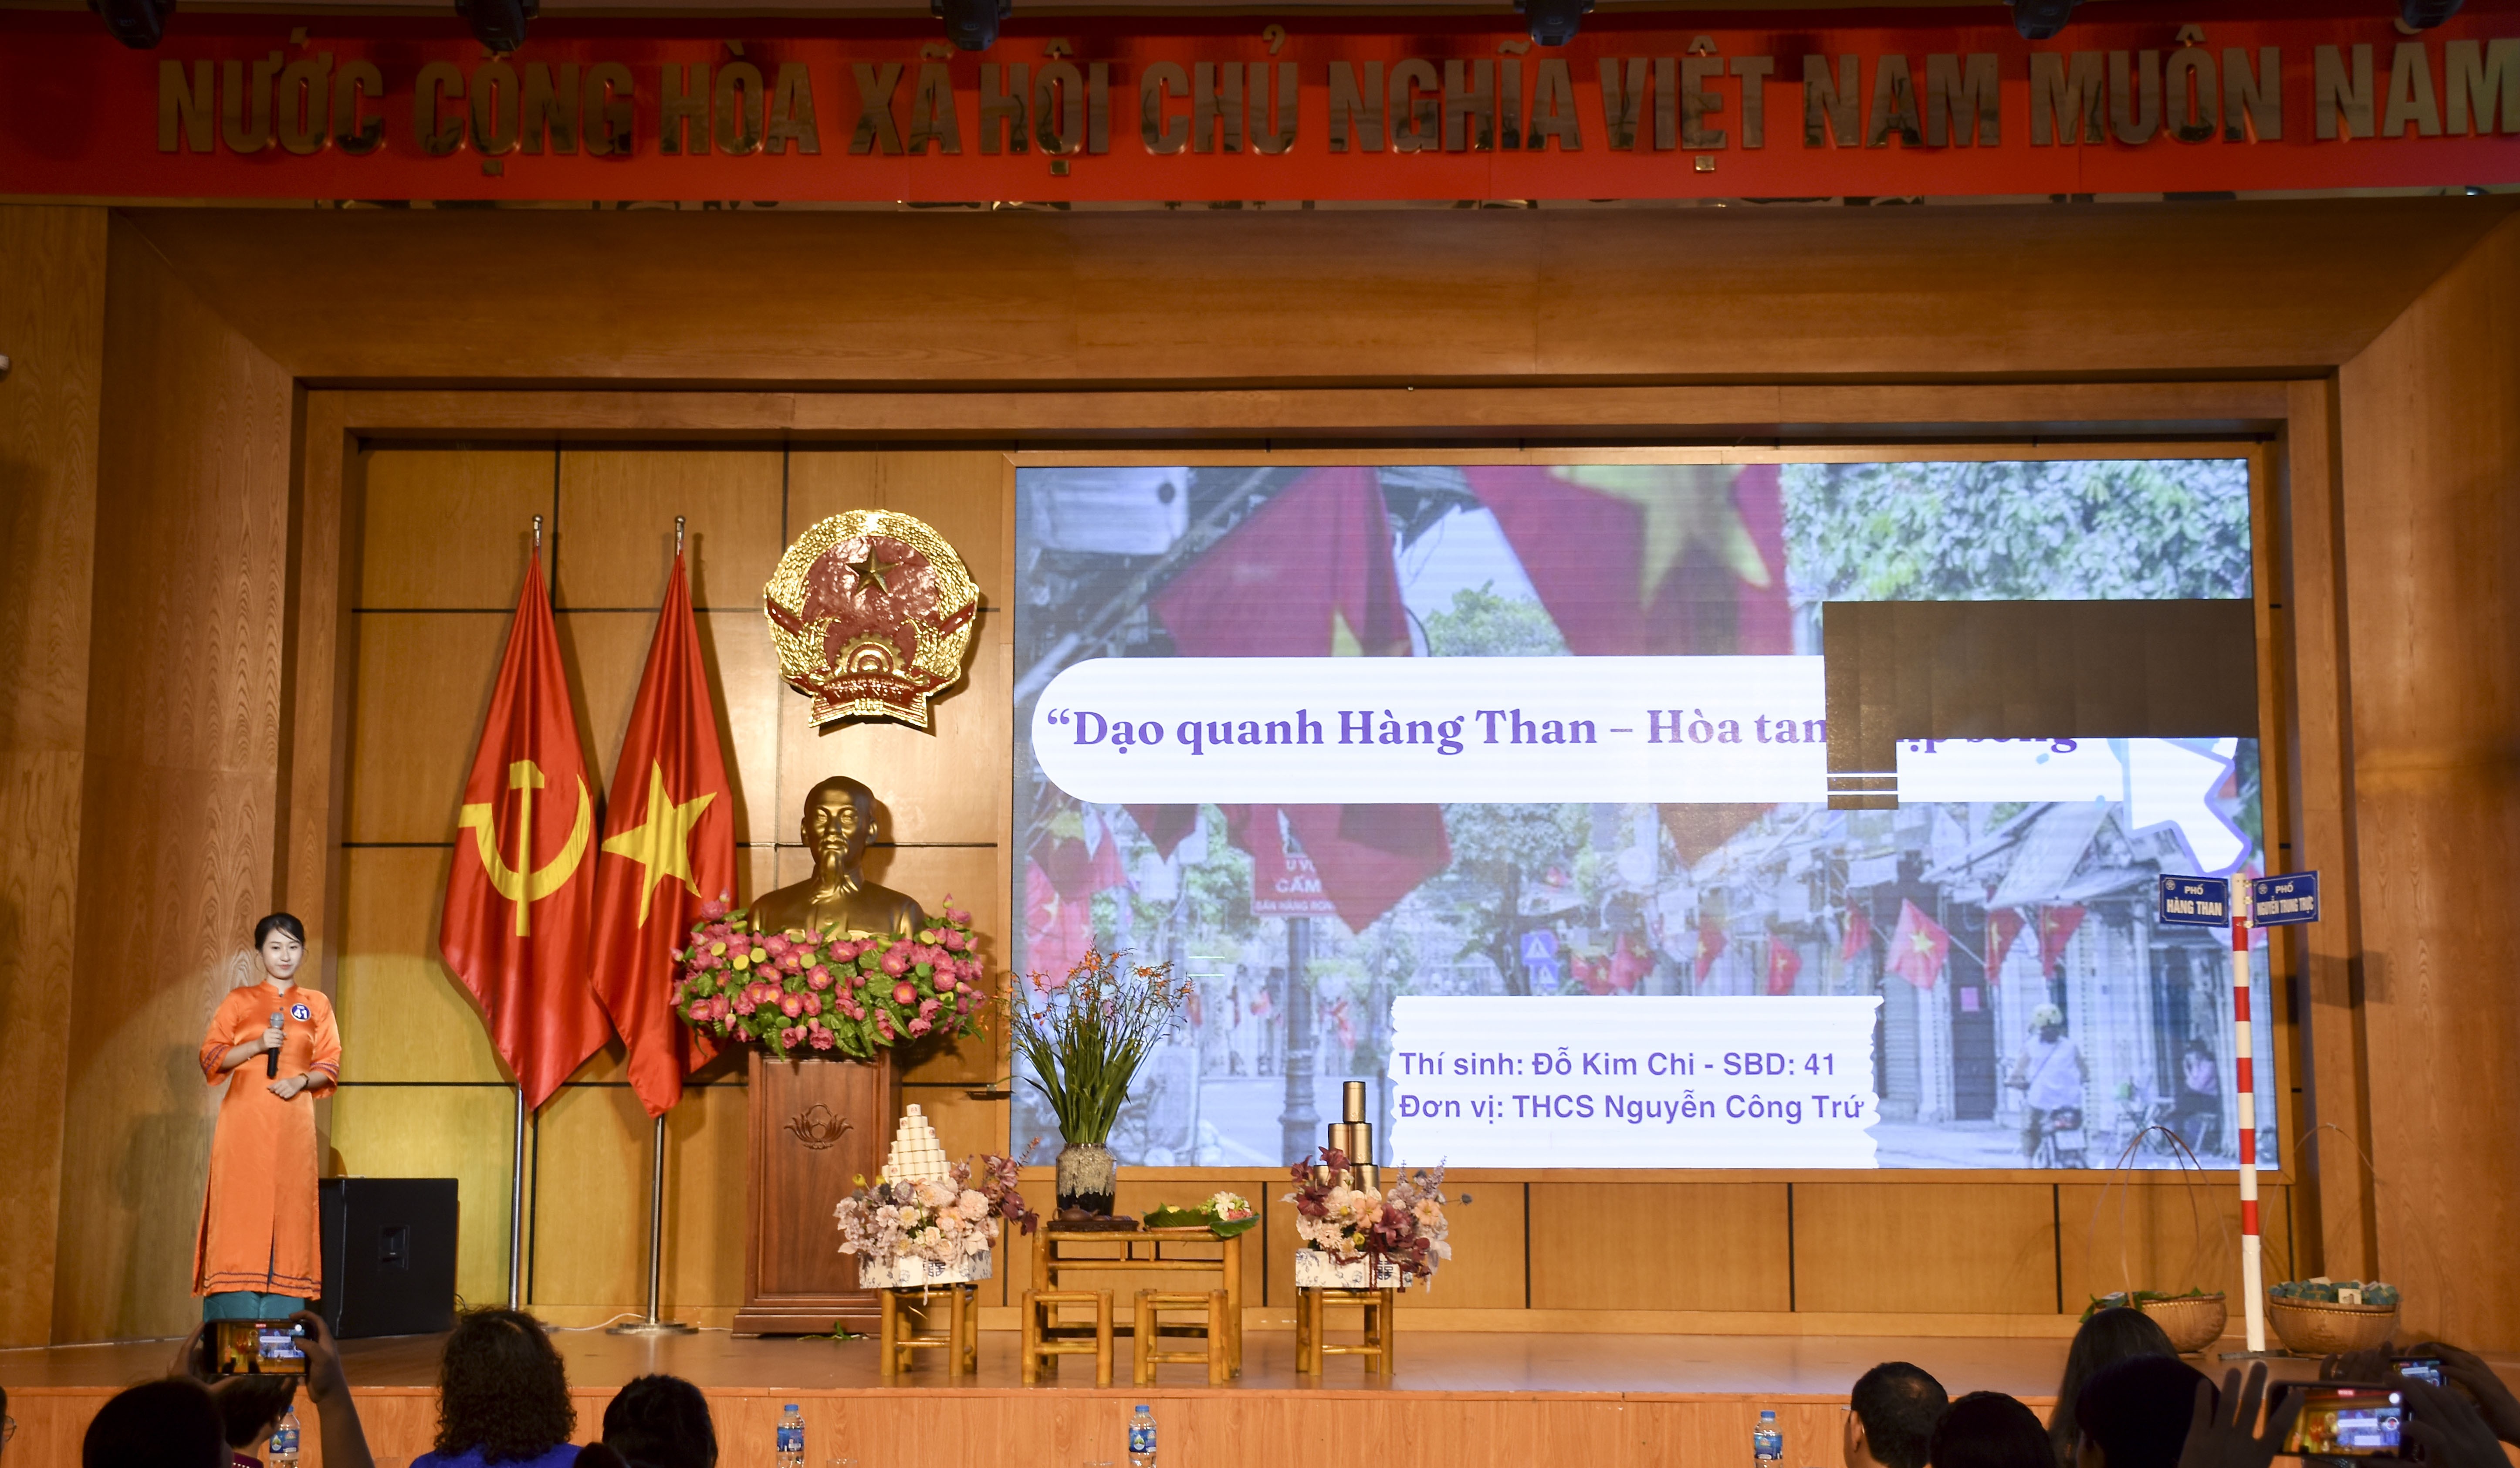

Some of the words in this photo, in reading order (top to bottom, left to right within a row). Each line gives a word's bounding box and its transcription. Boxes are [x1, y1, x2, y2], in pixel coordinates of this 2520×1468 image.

[158, 27, 383, 155] NƯỚC
[414, 48, 634, 176] CỘNG
[660, 40, 821, 156] HÒA
[848, 43, 961, 155] XÃ
[980, 38, 1109, 175] HỘI
[1140, 24, 1299, 155] CHỦ
[1328, 40, 1583, 154] NGHĨA
[1598, 35, 1774, 172] VIỆT
[1803, 53, 2000, 148] NAM
[2030, 24, 2283, 145] MUÔN
[1048, 708, 1164, 754] “Dạo
[1177, 709, 1324, 755] quanh
[1338, 709, 1465, 755] Hàng
[1475, 708, 1597, 744] Than
[1647, 708, 1742, 744] Hòa
[1754, 714, 1826, 744] tan
[2184, 883, 2204, 895] PHỐ
[2275, 880, 2294, 894] PHỐ
[2166, 896, 2194, 914] HÀNG
[2196, 901, 2222, 917] THAN
[294, 1009, 308, 1019] 41
[1399, 1052, 1444, 1075] Thí
[1454, 1052, 1522, 1076] sinh:
[1532, 1046, 1572, 1076] Đỗ
[1583, 1052, 1637, 1075] Kim
[1648, 1052, 1694, 1076] Chi
[1724, 1052, 1794, 1076] SBD:
[1805, 1053, 1833, 1075] 41
[1399, 1095, 1460, 1118] Đơn
[1471, 1095, 1503, 1124] vị:
[1512, 1094, 1594, 1118] THCS
[1606, 1089, 1715, 1124] Nguyễn
[1726, 1094, 1802, 1125] Công
[1812, 1094, 1864, 1119] Trứ
